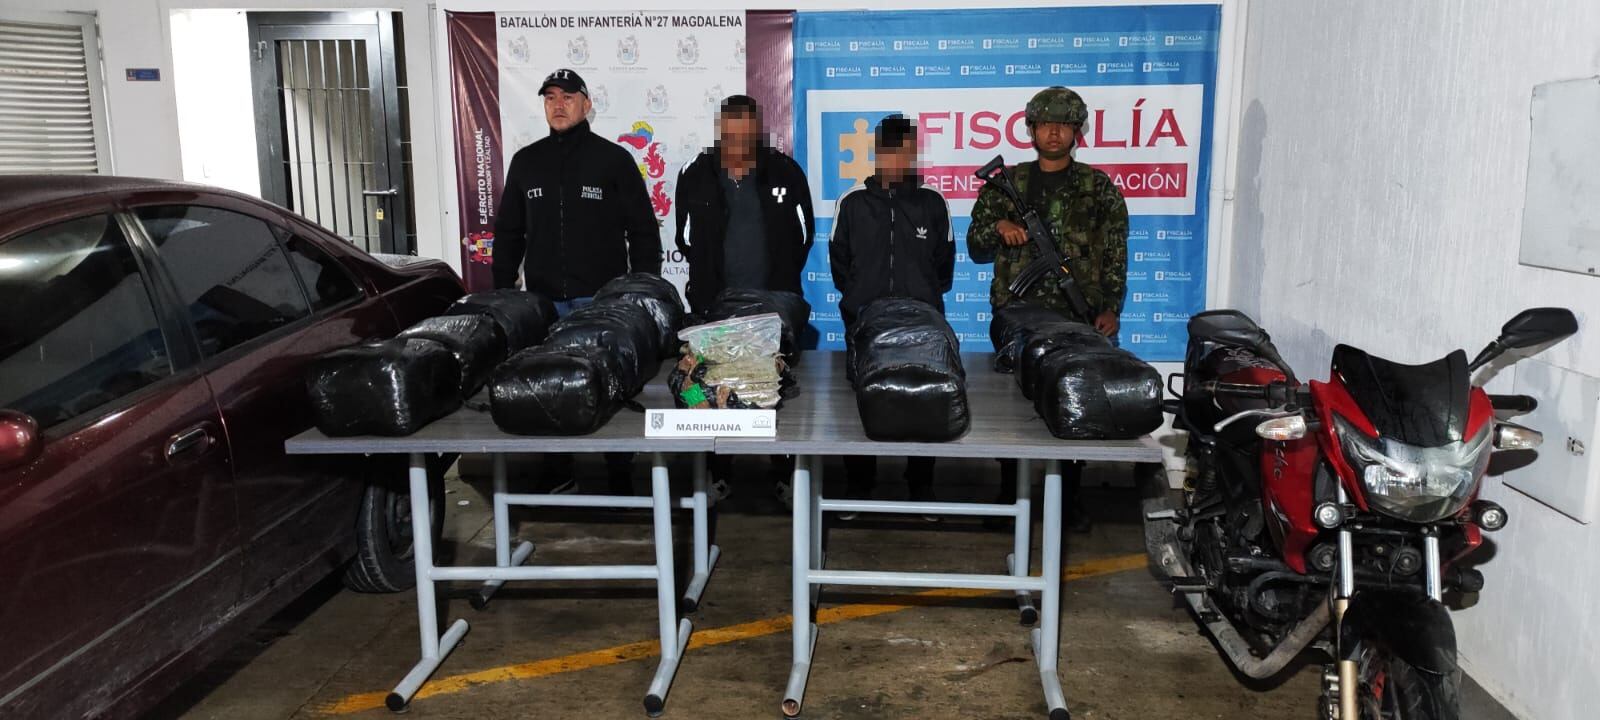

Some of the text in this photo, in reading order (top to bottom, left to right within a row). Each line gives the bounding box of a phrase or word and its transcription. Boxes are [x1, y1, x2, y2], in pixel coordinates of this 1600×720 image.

[500, 14, 557, 28] BATALLÓN
[560, 16, 575, 28] DE
[578, 13, 643, 28] INFANTERÍA
[672, 15, 743, 28] MAGDALENA
[475, 127, 488, 225] EJÉRCITO NACIONAL
[1108, 167, 1180, 190] ACIÓN
[527, 187, 543, 199] CTI
[676, 423, 742, 432] MARIHUANA
